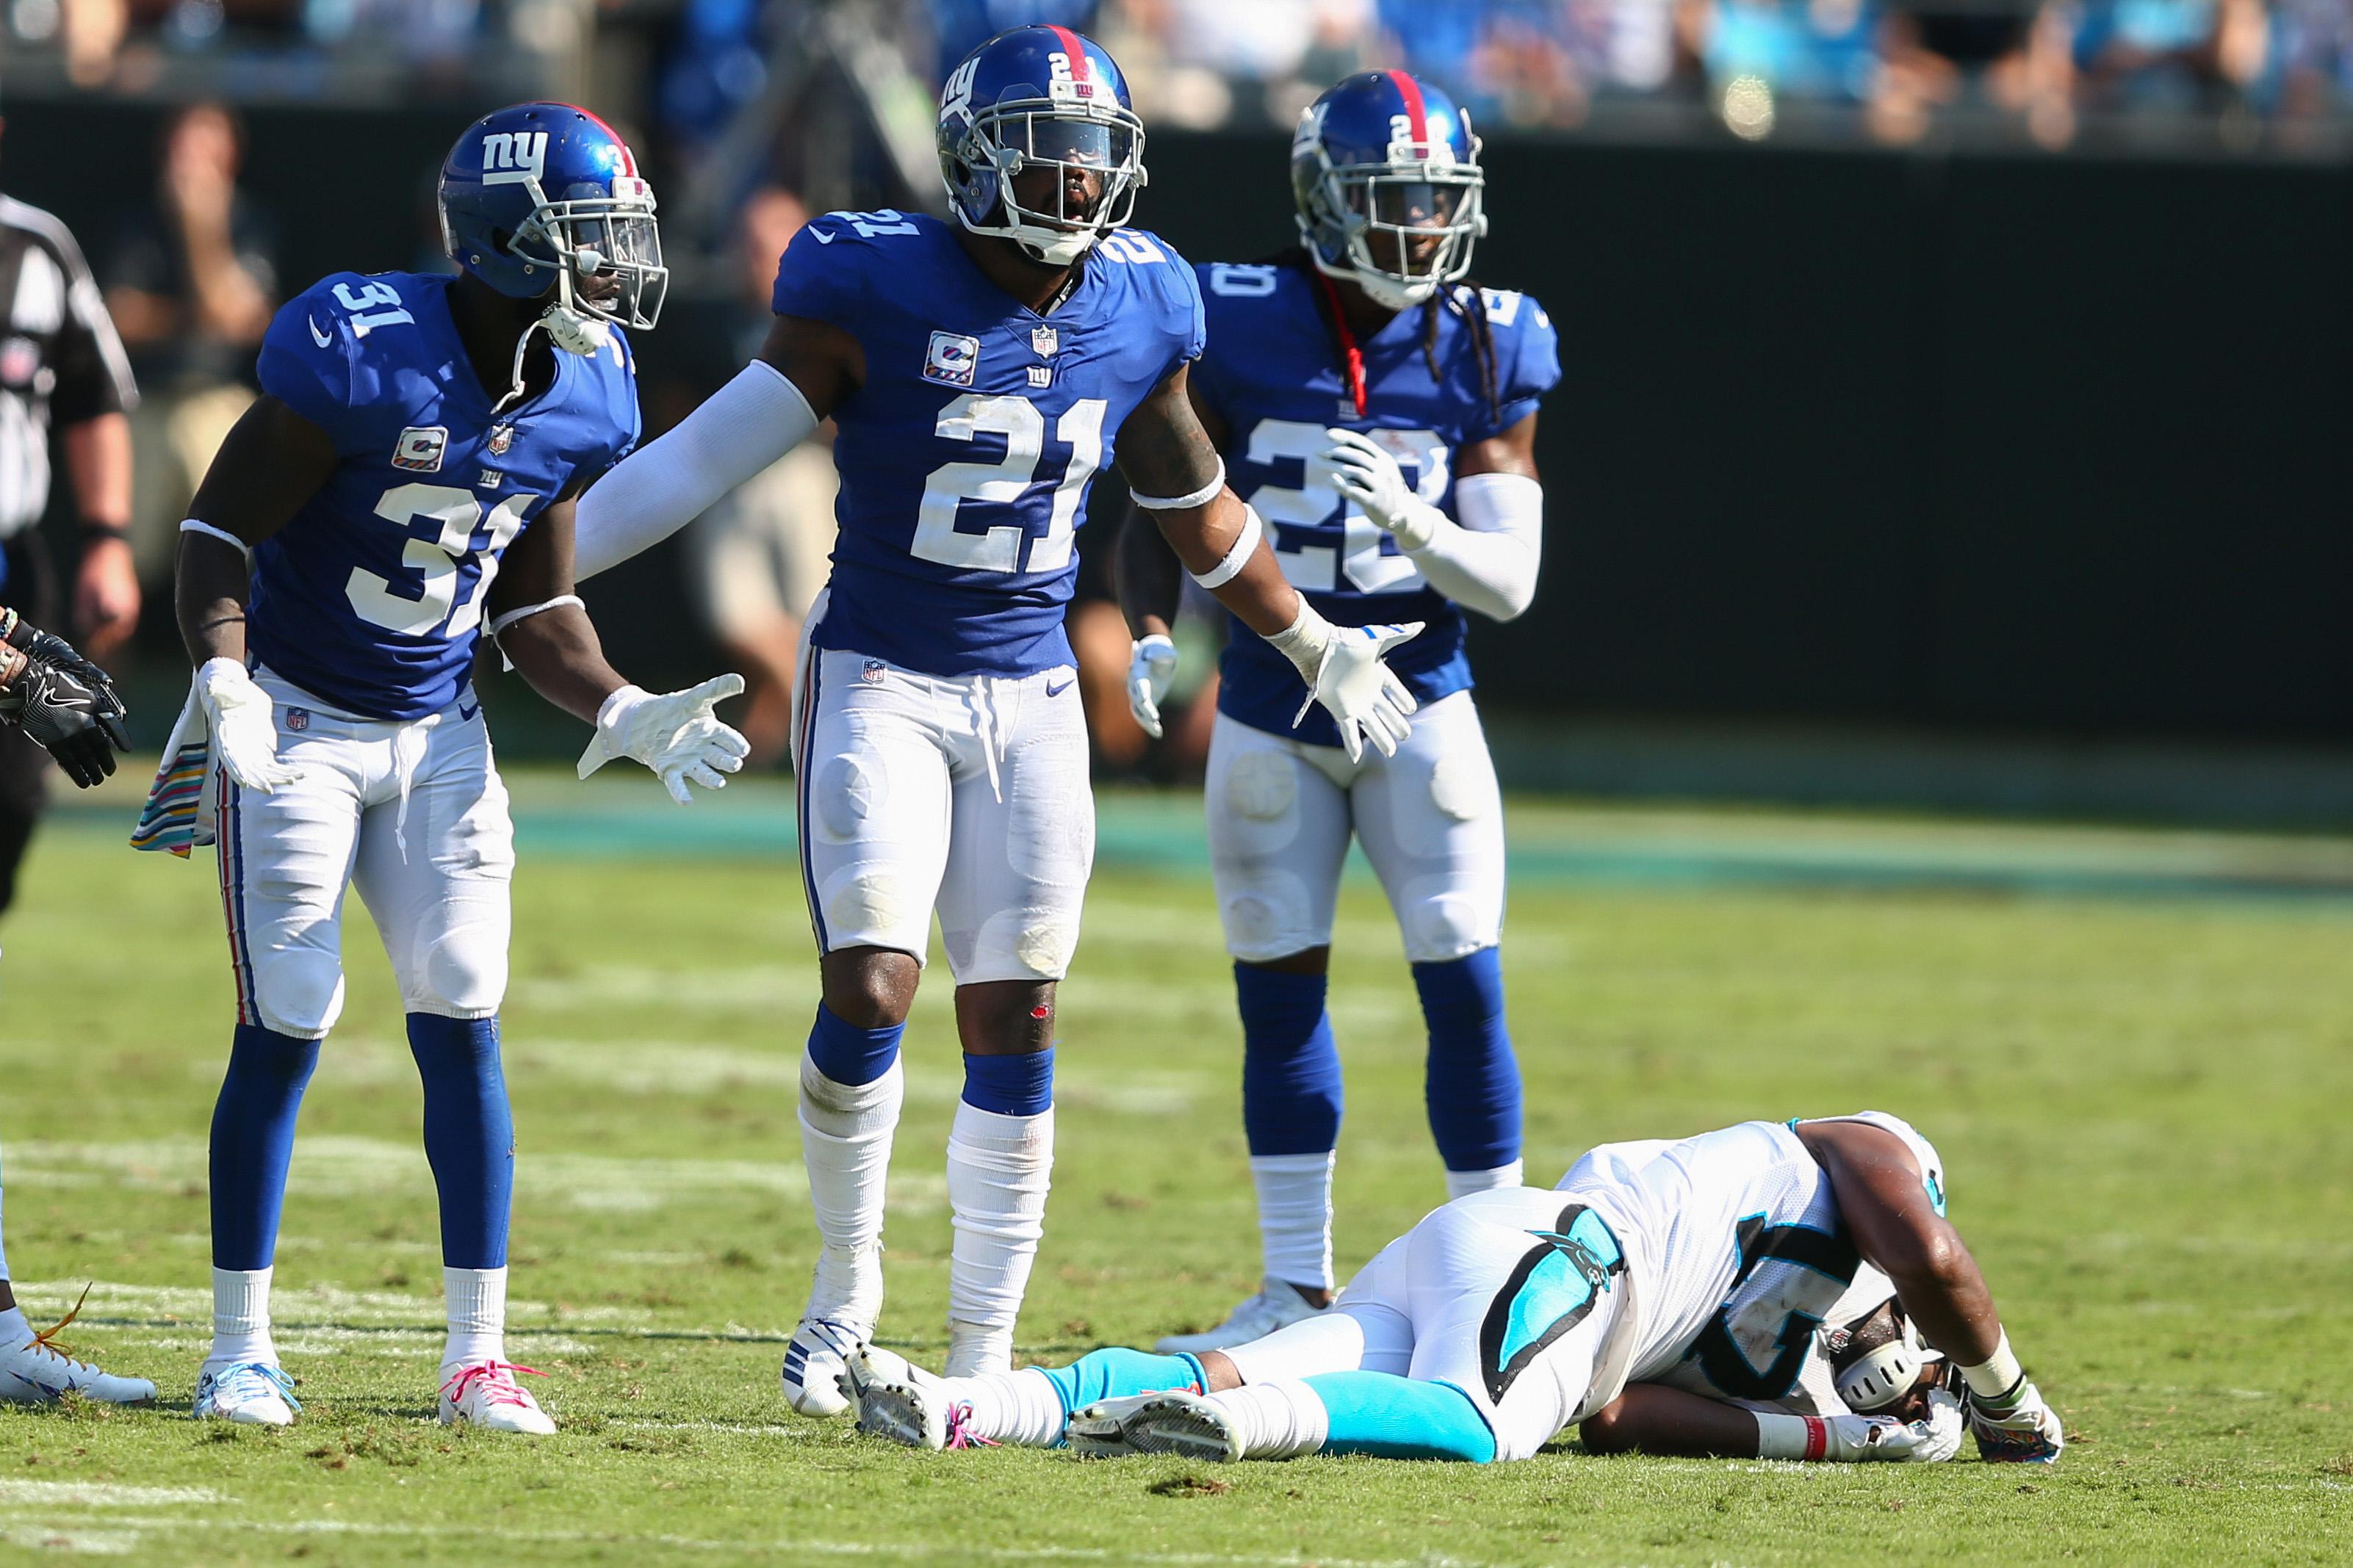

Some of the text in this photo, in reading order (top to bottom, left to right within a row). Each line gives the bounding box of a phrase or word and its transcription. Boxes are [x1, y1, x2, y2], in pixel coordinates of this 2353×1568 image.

[483, 131, 549, 186] ny
[824, 209, 920, 238] 21
[331, 281, 415, 339] 31
[931, 335, 974, 372] C
[400, 430, 442, 460] C
[910, 393, 1108, 574] 21
[345, 482, 540, 638] 31
[288, 715, 307, 729] NFL
